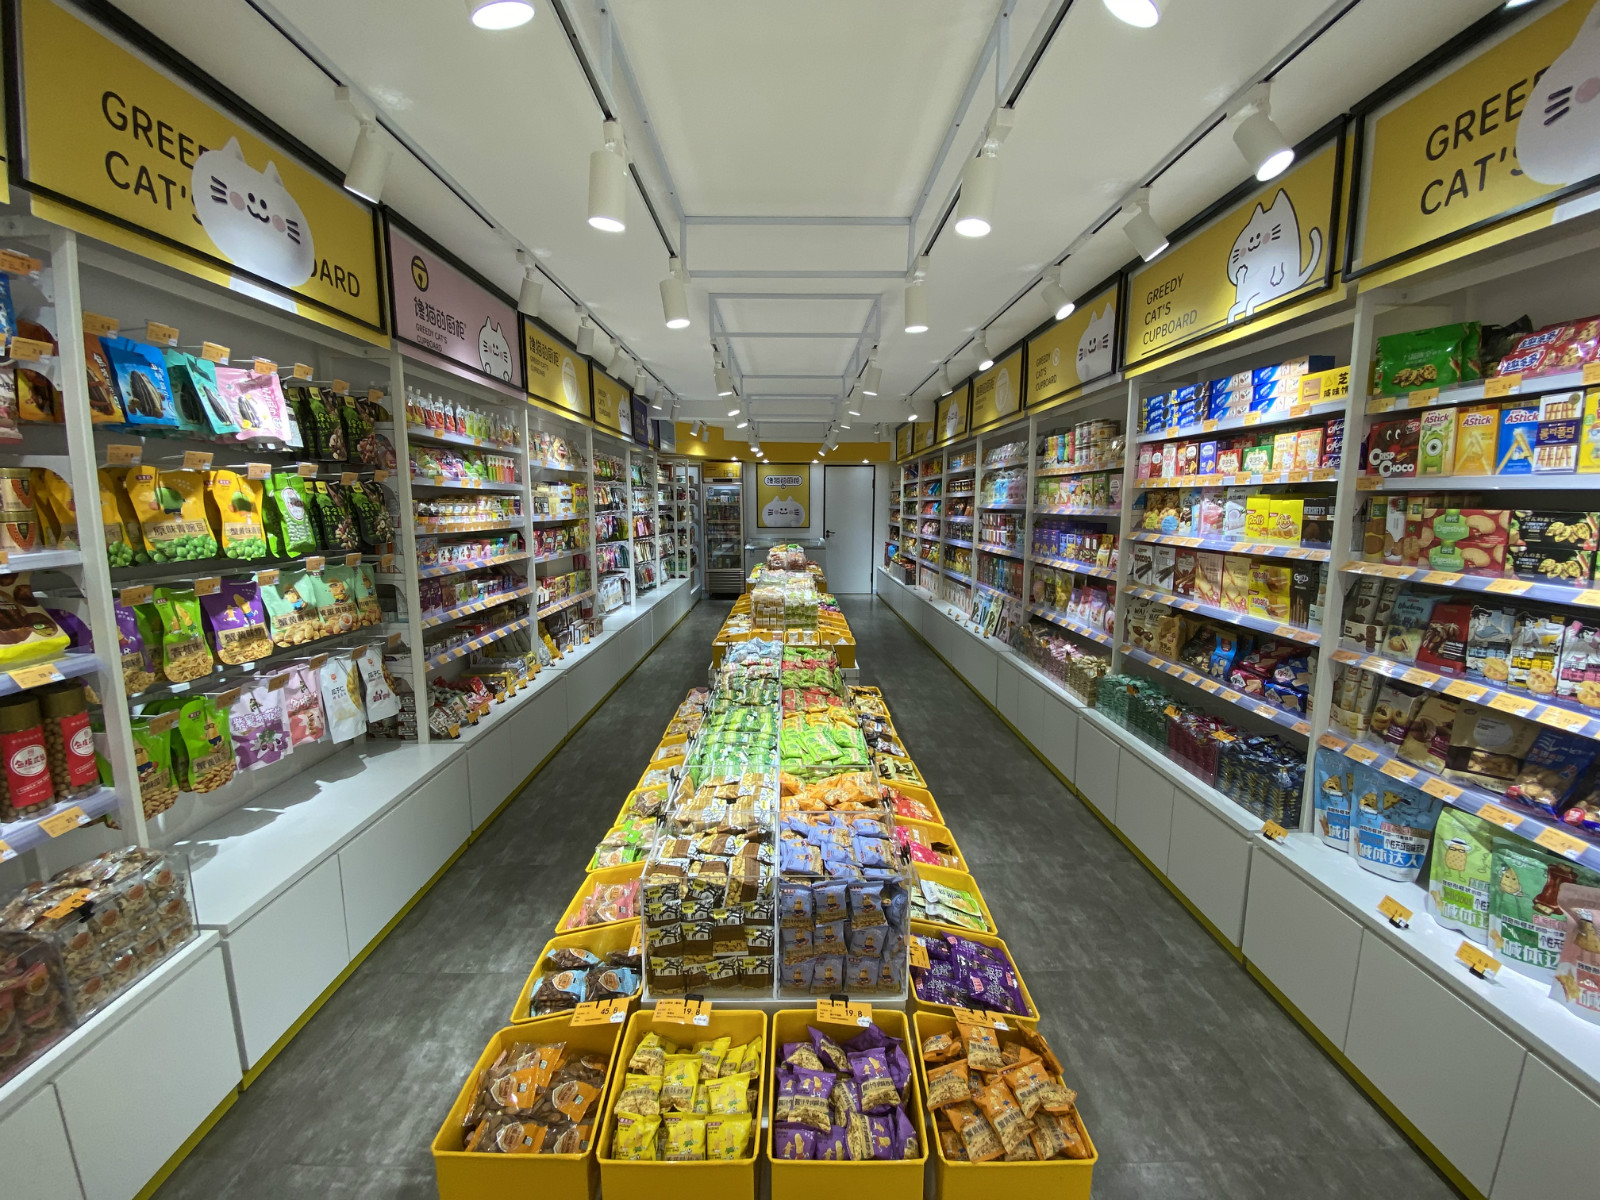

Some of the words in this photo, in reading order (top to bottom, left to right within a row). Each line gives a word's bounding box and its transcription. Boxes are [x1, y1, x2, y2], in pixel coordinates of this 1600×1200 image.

[1146, 272, 1184, 305] GREEDY
[1144, 301, 1171, 326] CAT'S
[415, 322, 434, 338] GREEDY
[1143, 309, 1198, 345] CUPBOARD
[416, 334, 443, 352] CUPBOARD
[1424, 413, 1449, 423] AStick
[1462, 414, 1492, 426] AStick
[1379, 460, 1414, 477] CHOCO
[1304, 506, 1325, 515] HERSHEY'S
[1436, 524, 1466, 534] Digestive
[1431, 555, 1461, 565] Digestive
[601, 1006, 618, 1015] 45.8
[683, 1007, 700, 1016] 19.8
[845, 1009, 863, 1018] 19.8
